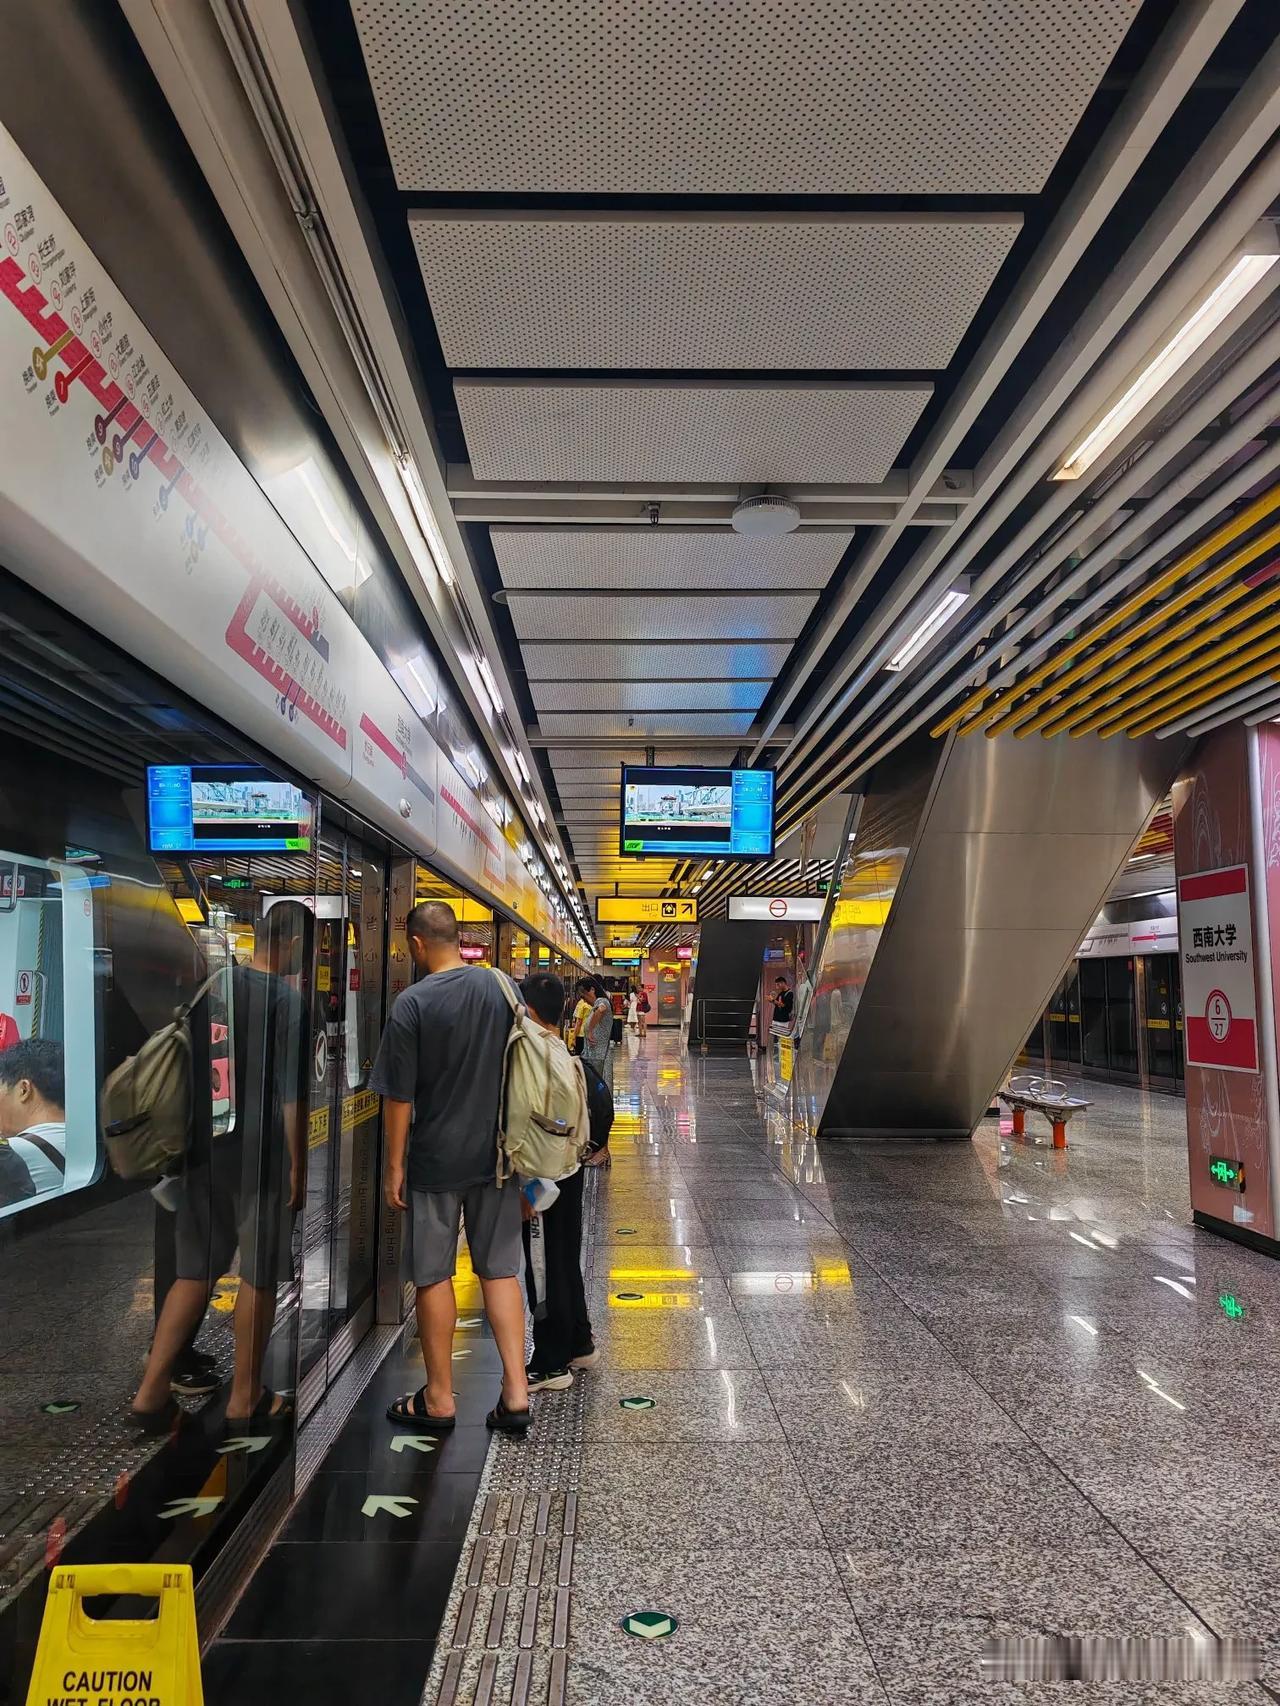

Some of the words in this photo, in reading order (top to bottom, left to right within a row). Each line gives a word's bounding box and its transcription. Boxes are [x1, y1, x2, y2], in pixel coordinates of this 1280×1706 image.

[1193, 923, 1237, 948] 西南大学
[1185, 952, 1216, 963] Southwest
[1216, 950, 1248, 963] University
[1215, 999, 1221, 1015] 6
[1214, 1023, 1223, 1036] 27
[63, 1671, 152, 1692] CAUTION
